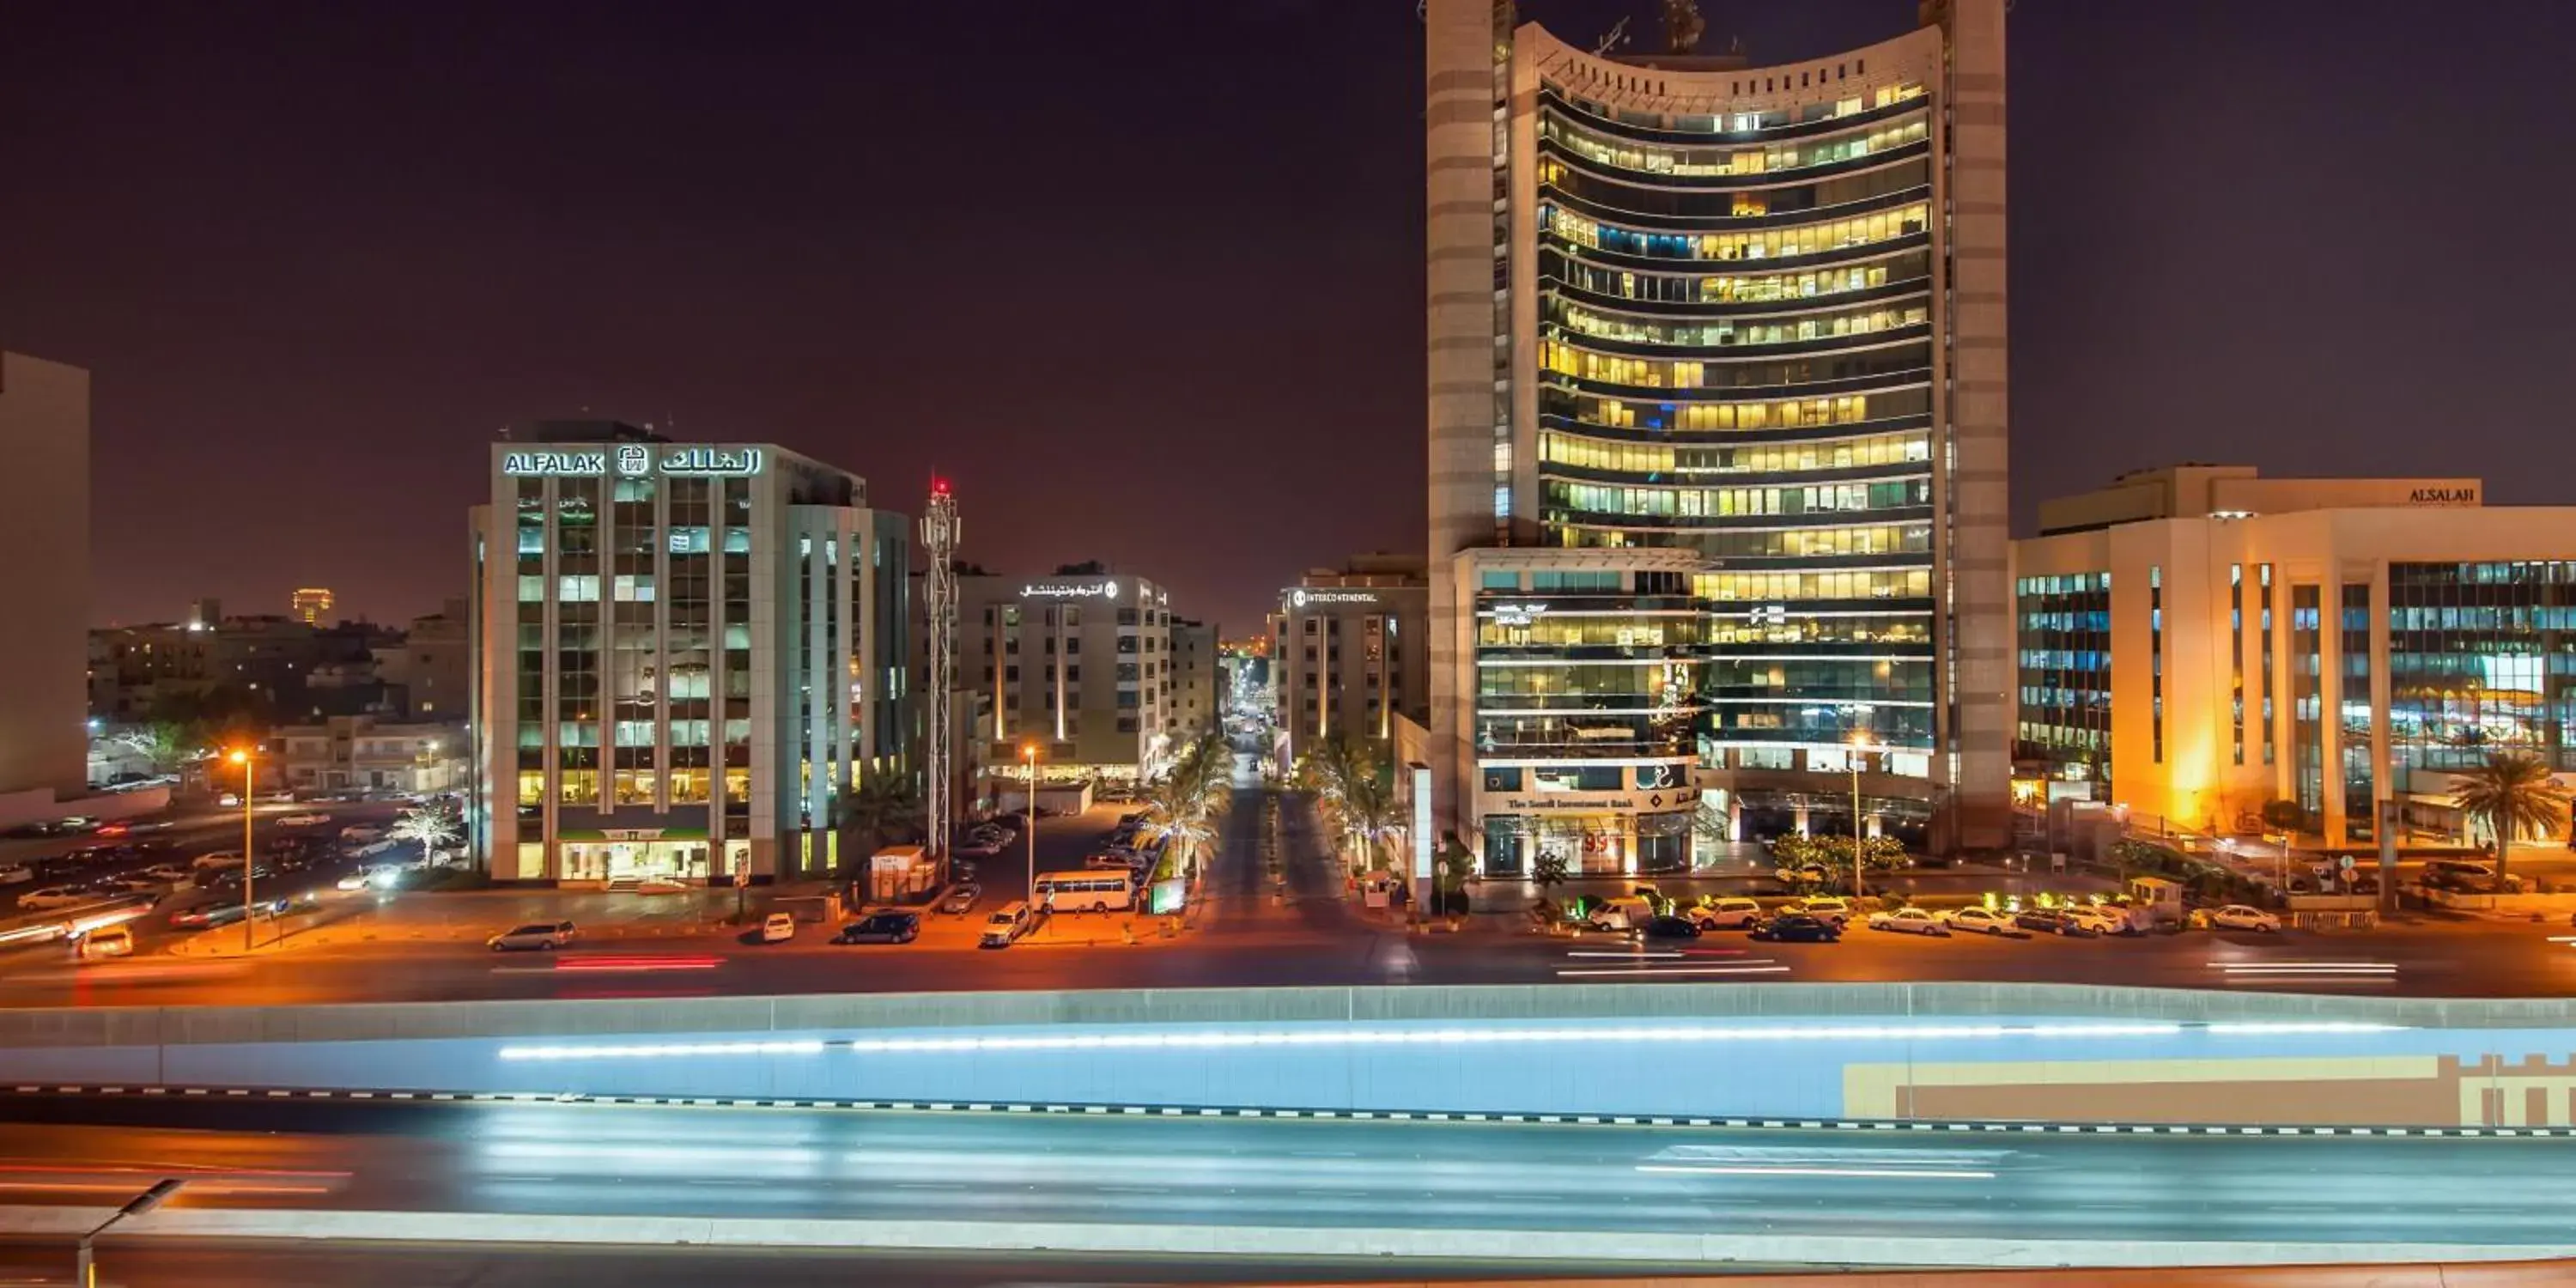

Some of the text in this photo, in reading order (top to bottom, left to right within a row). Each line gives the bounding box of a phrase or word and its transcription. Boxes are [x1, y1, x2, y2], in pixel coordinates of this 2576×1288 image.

[505, 453, 605, 473] ALFALAK
[659, 448, 762, 474] الفلك
[2409, 489, 2474, 502] ALSALAH
